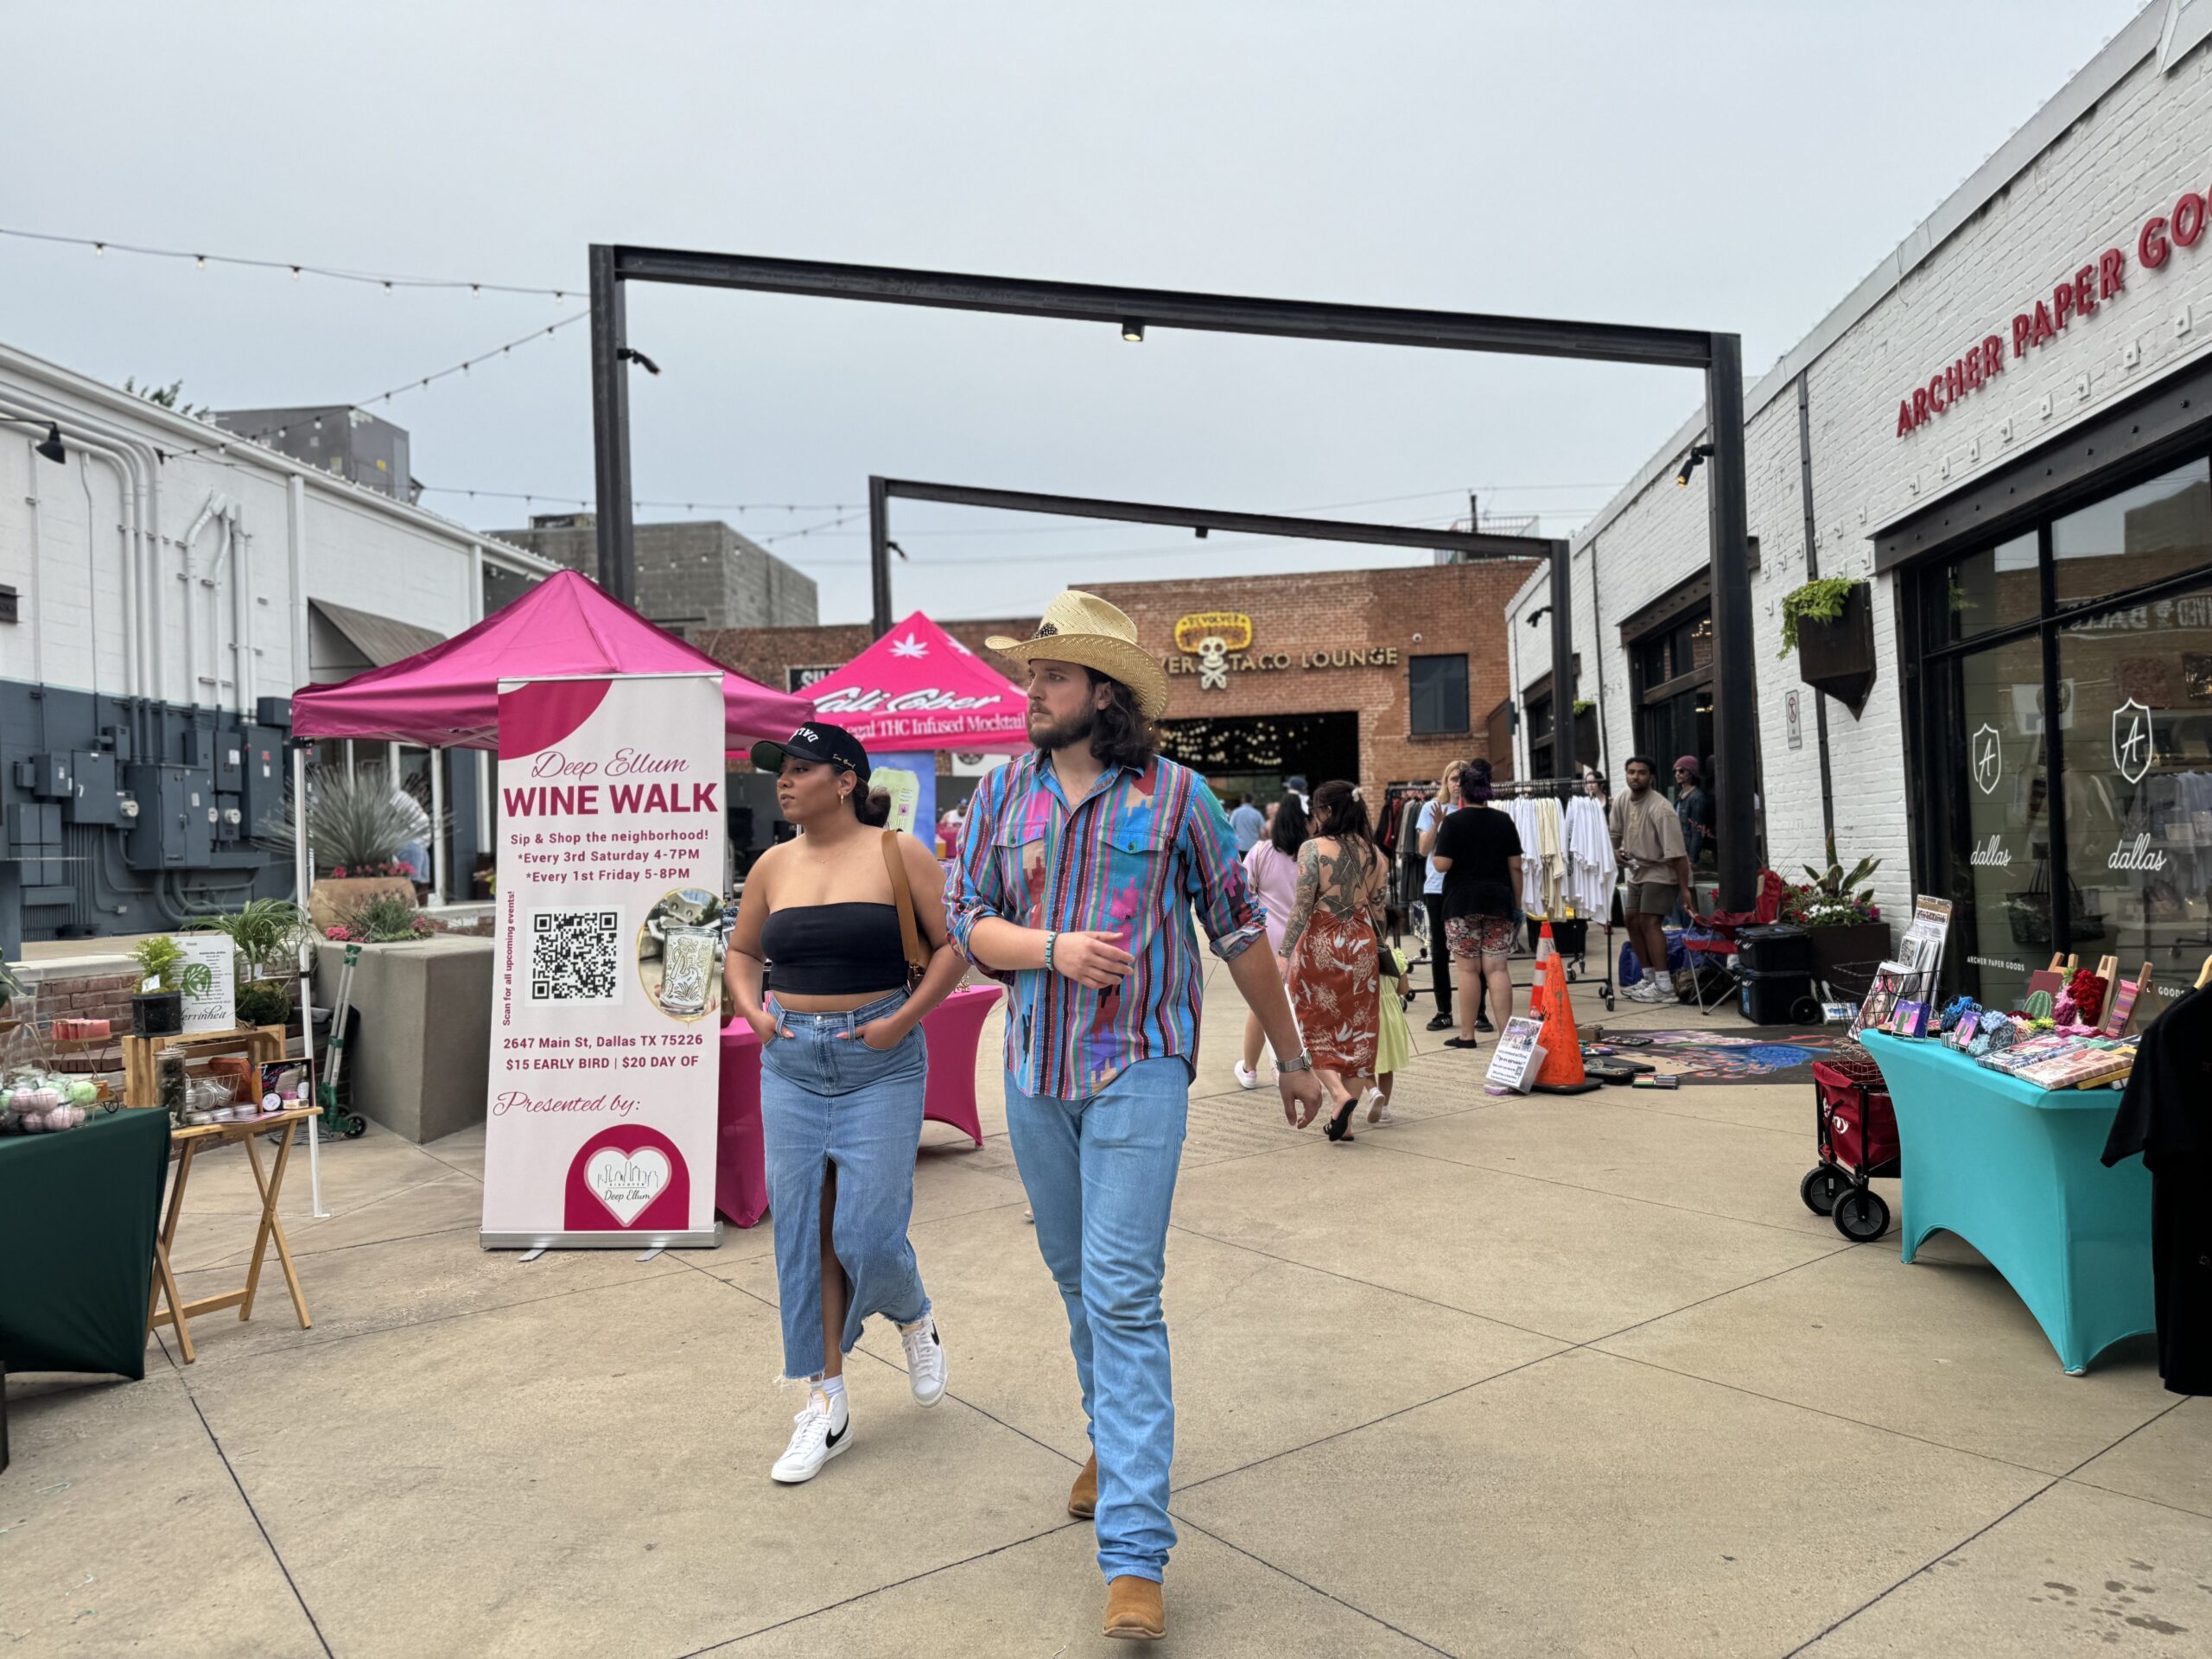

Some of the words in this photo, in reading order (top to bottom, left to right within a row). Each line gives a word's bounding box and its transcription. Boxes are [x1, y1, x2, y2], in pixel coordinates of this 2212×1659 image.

[1897, 334, 2002, 438] ARCHER
[2012, 248, 2123, 359] PAPER
[2138, 180, 2212, 269] GO
[1229, 652, 1291, 671] TACO
[1302, 647, 1398, 669] LOUNGE
[881, 688, 1002, 715] Sober
[839, 720, 875, 740] egal
[876, 718, 910, 736] THC
[912, 716, 963, 735] Infused
[531, 751, 598, 781] Deep
[605, 747, 690, 777] Ellum
[503, 785, 600, 817] WINE
[609, 783, 718, 814] WALK
[511, 834, 531, 846] Sip
[535, 834, 543, 844] &
[549, 832, 581, 846] Shop
[586, 831, 607, 842] the
[611, 830, 709, 844] neighborhood!
[563, 850, 586, 862] 3rd
[590, 849, 650, 864] Saturday
[653, 849, 700, 861] 4-7PM
[1970, 835, 2011, 867] dallas
[2108, 832, 2166, 871] dallas
[572, 870, 594, 881] 1st
[599, 869, 639, 883] Friday
[645, 868, 690, 880] 5-8PM
[505, 925, 516, 971] upcoming
[1967, 956, 1986, 965] ARCHER
[1988, 959, 2005, 968] PAPER
[2005, 962, 2024, 971] GOODS
[504, 973, 512, 985] all
[503, 1037, 535, 1049] 2647
[538, 1037, 570, 1049] Main
[575, 1037, 593, 1050] St,
[596, 1035, 636, 1047] Dallas
[640, 1035, 657, 1046] TX
[661, 1034, 703, 1046] 75226
[505, 1058, 530, 1071] $15
[533, 1058, 575, 1071] EARLY
[578, 1058, 610, 1069] BIRD
[622, 1056, 646, 1069] $20
[651, 1056, 677, 1067] DAY
[680, 1055, 699, 1067] OF
[493, 1091, 607, 1116] Presented
[610, 1094, 640, 1117] by:
[605, 1189, 624, 1203] Deep
[626, 1189, 650, 1200] Ellum
